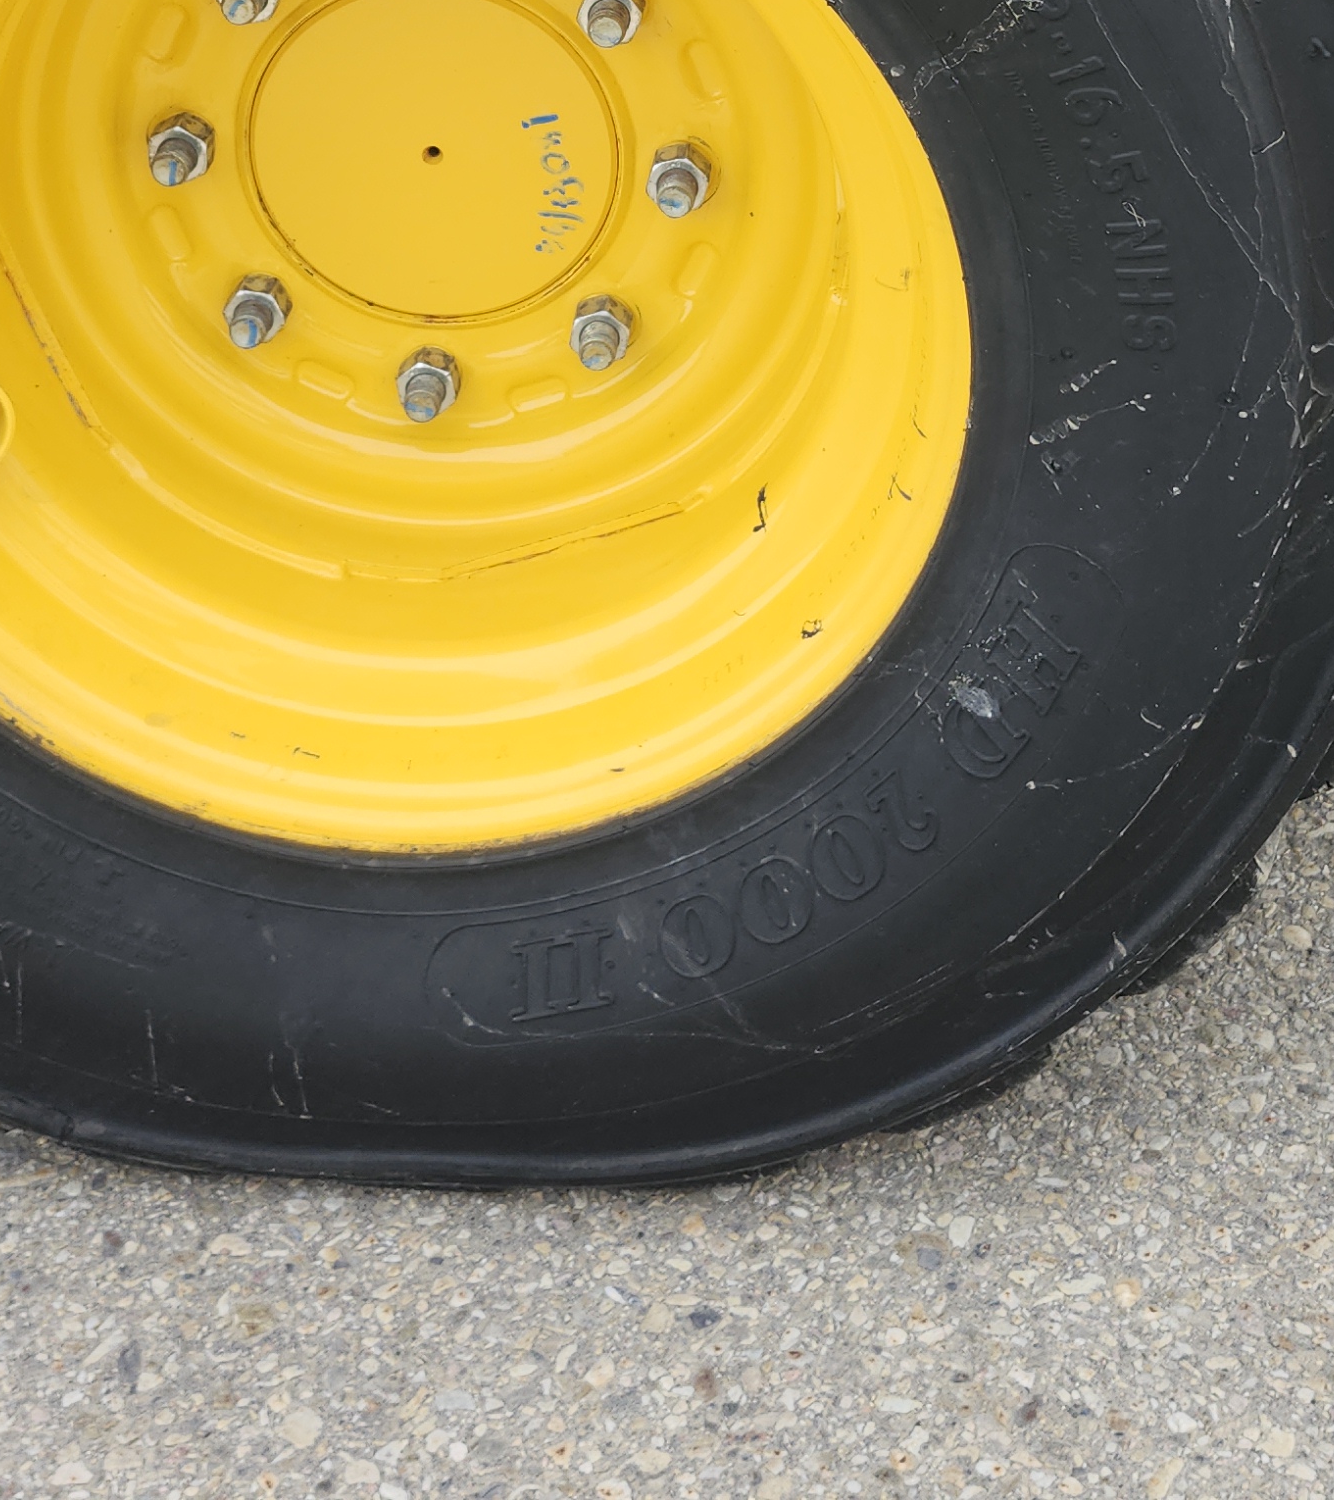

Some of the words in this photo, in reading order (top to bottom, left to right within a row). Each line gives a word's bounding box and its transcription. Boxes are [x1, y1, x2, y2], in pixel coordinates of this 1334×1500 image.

[1103, 215, 1177, 352] NHS
[927, 572, 1083, 780] HD
[659, 768, 939, 980] 2000
[509, 925, 615, 1024] II
